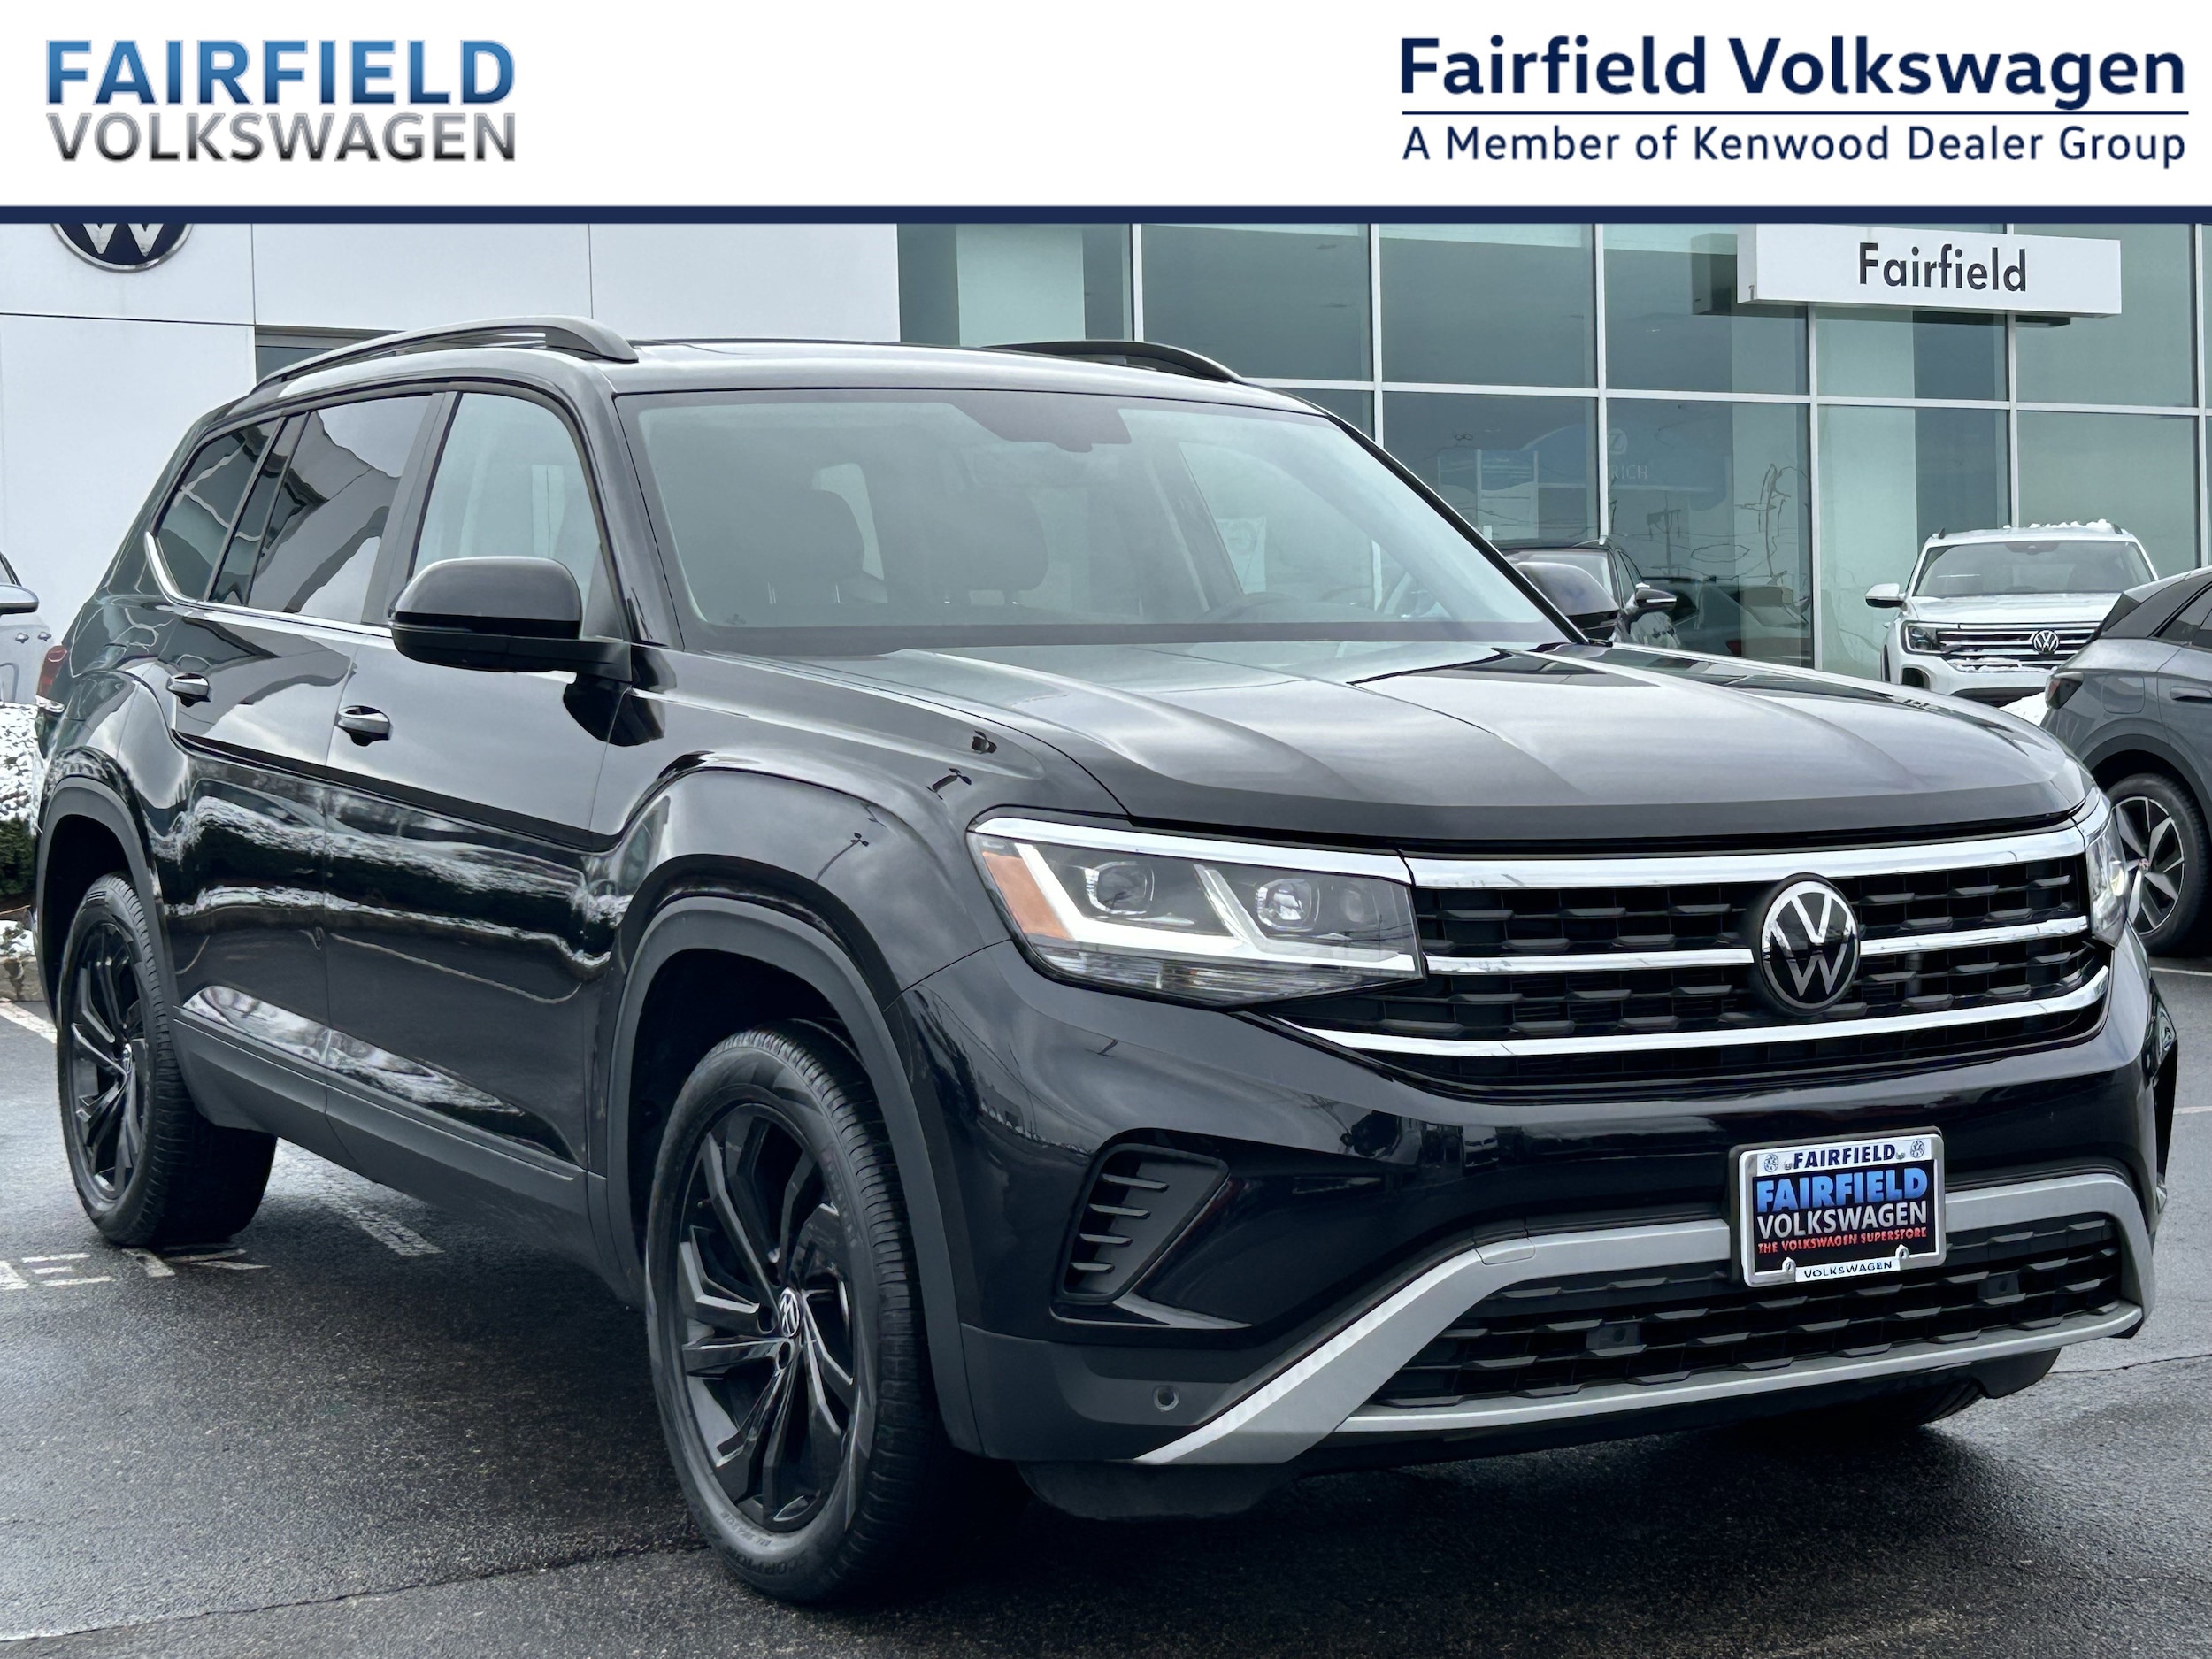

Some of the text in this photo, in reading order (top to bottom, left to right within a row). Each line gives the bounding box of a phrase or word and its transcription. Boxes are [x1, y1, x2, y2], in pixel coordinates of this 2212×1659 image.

[1859, 242, 2026, 292] Fairfield
[1793, 1144, 1895, 1170] FAIRFIELD
[1756, 1167, 1928, 1213] FAIRFIELD
[1757, 1200, 1927, 1239] VOLKSWAGEN
[1758, 1226, 1927, 1254] THE VOLKSWAGEN SUPERSTORE
[1804, 1261, 1892, 1279] VOLKSWAGEN
